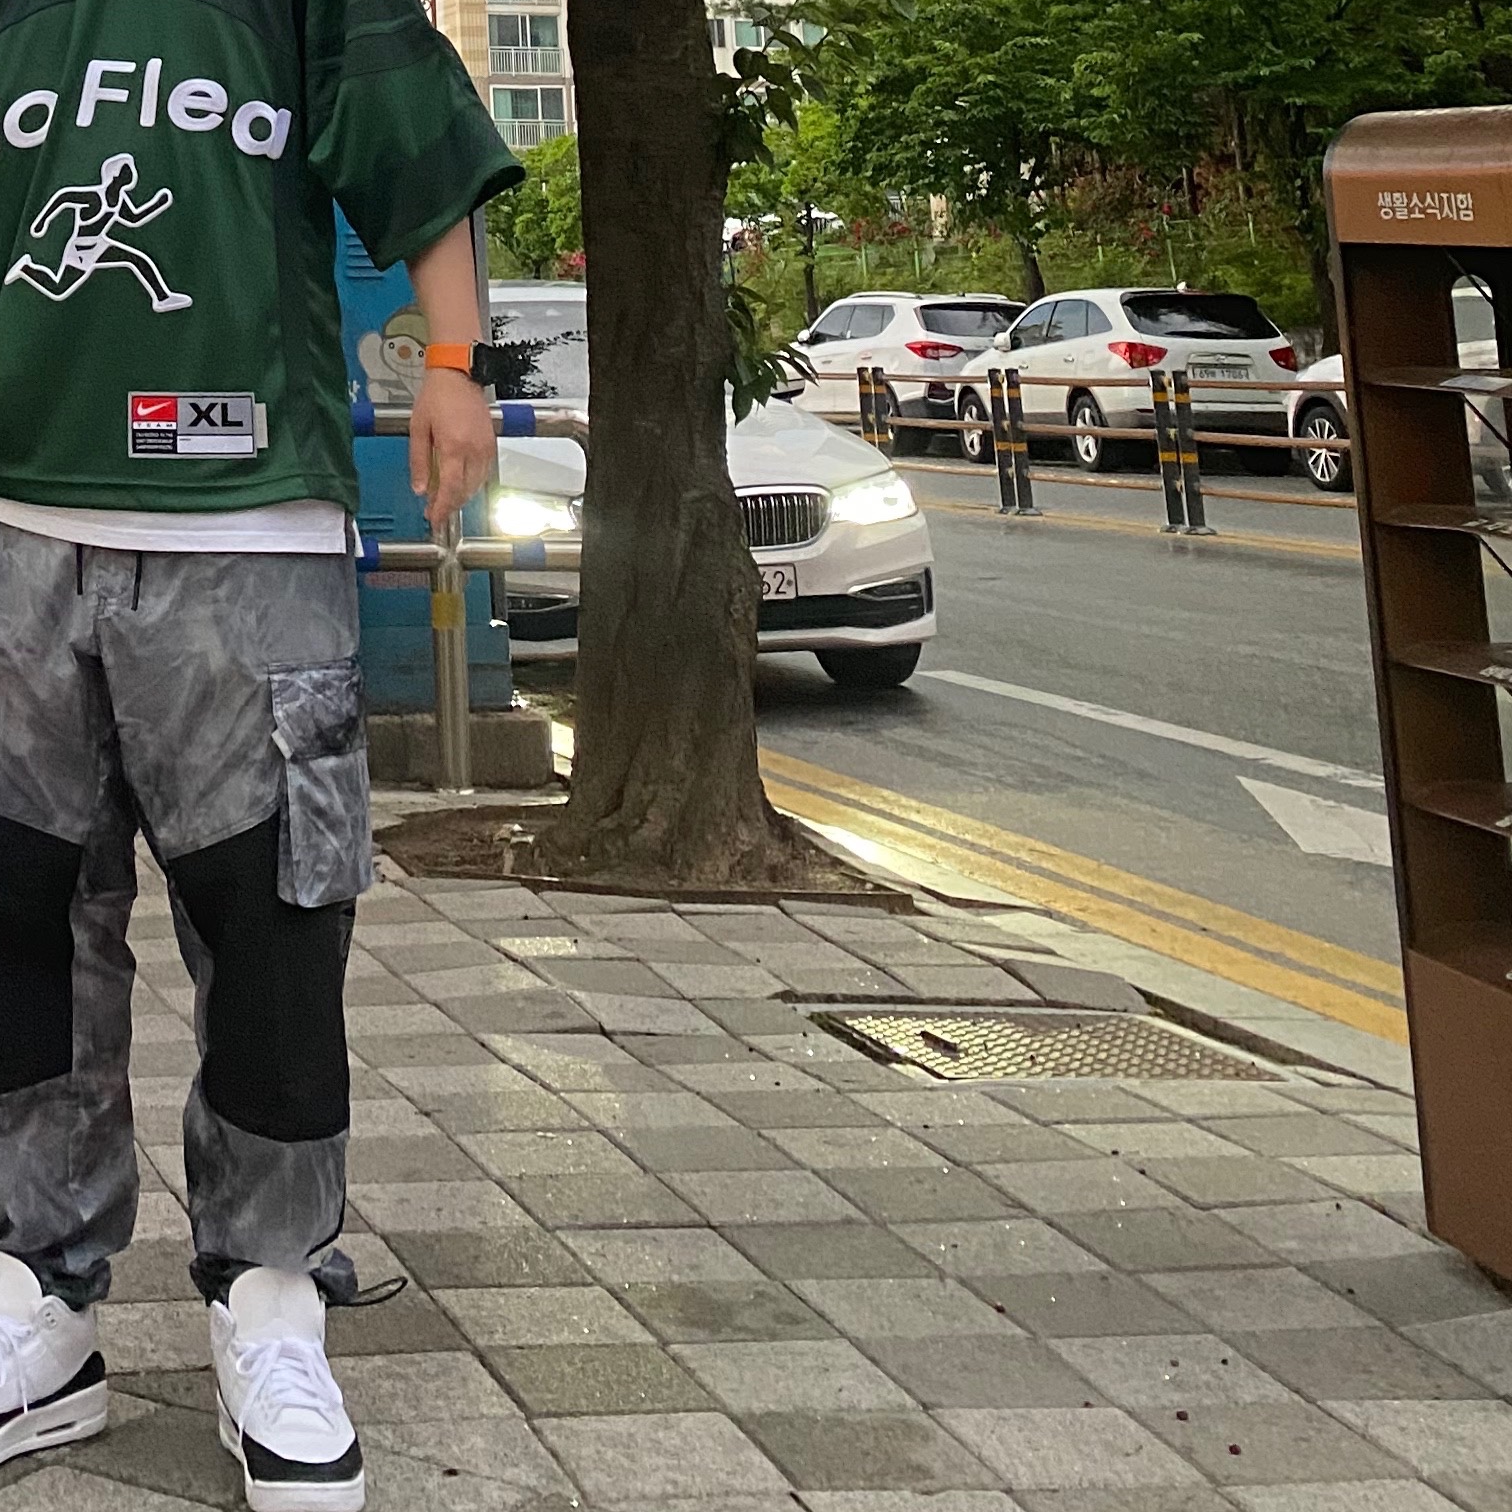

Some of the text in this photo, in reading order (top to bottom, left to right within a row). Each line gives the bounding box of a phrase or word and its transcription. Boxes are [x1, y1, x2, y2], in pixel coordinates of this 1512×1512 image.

[76, 57, 292, 160] Flea
[1377, 191, 1474, 221] 생활소식지함
[188, 402, 244, 427] XL
